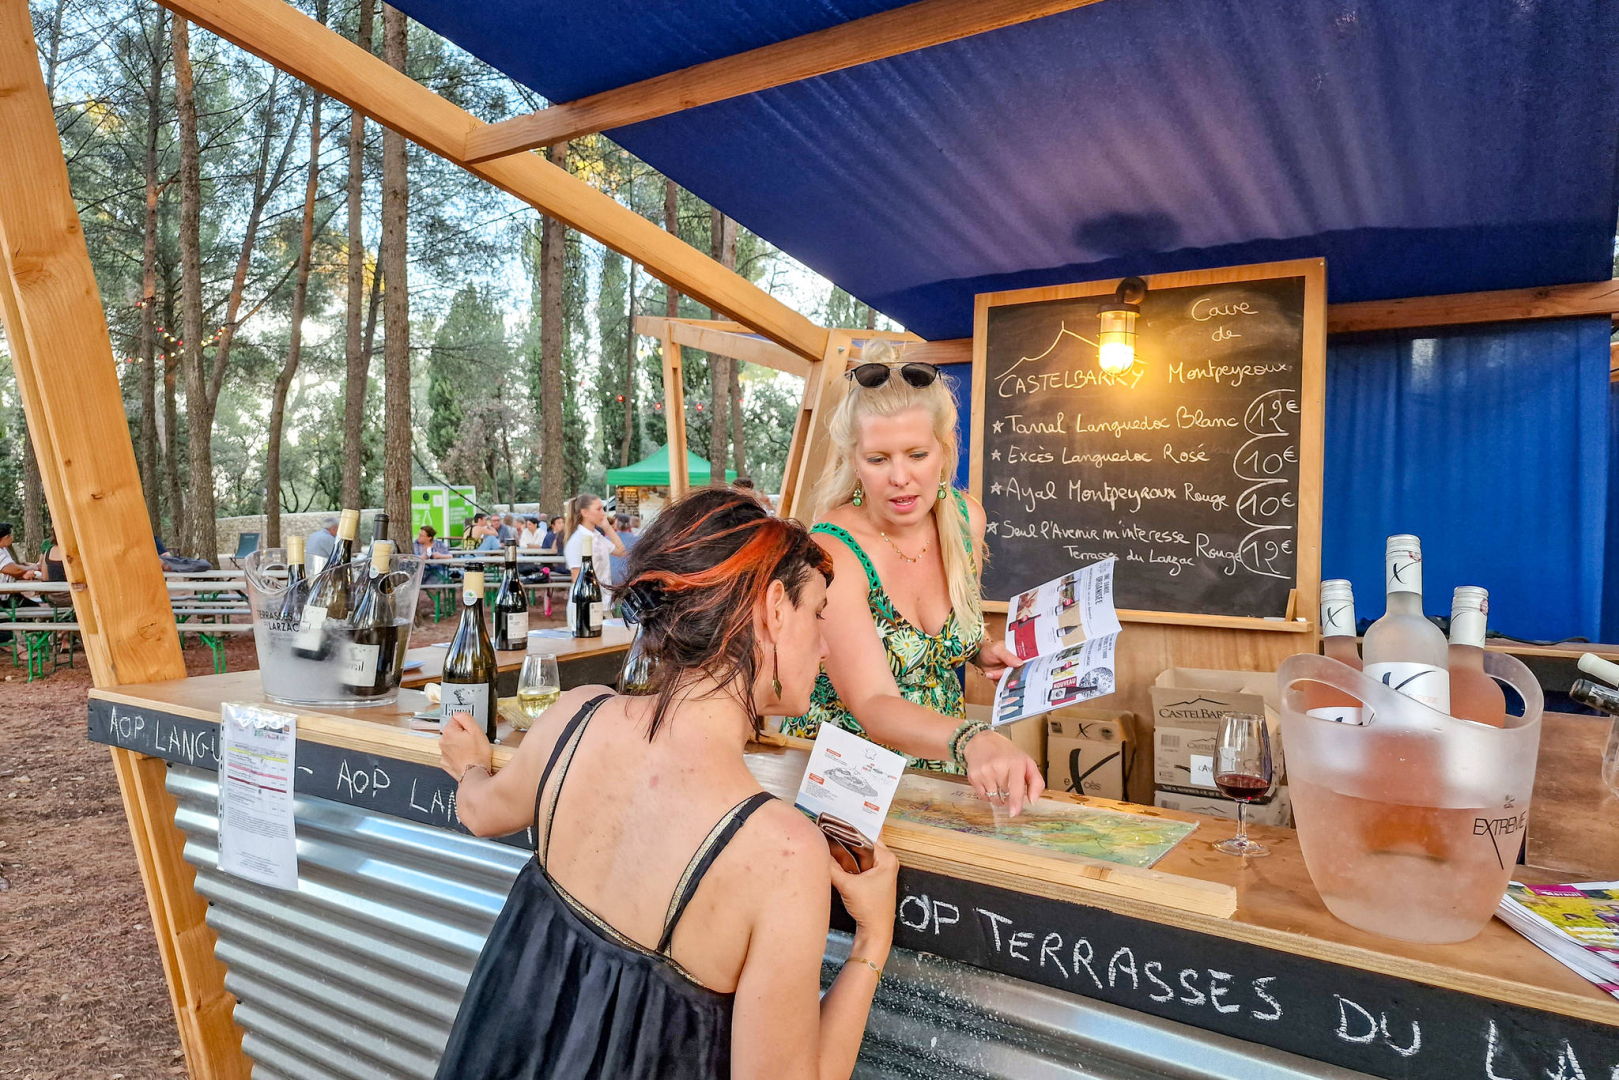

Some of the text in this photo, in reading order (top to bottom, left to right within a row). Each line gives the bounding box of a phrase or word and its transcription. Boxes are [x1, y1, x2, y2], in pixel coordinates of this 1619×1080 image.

[1191, 298, 1259, 321] Cave
[1211, 326, 1242, 342] de
[1168, 359, 1288, 387] Montpeyroux
[1076, 413, 1170, 438] Languedoc
[1176, 405, 1240, 429] Blanc
[1062, 446, 1152, 469] Languedoc
[1163, 443, 1211, 464] Rosé
[1243, 445, 1298, 474] 10€
[1184, 482, 1229, 512] Rouge
[1239, 491, 1296, 516] 10€
[1001, 519, 1039, 539] Seul
[1196, 532, 1242, 576] Rouge
[1126, 549, 1145, 563] du
[1149, 549, 1195, 576] Larzac
[268, 622, 299, 633] LARZAC
[110, 705, 145, 744] AOP
[336, 759, 391, 799] AOP
[899, 894, 960, 936] OP
[973, 906, 1284, 1022] TERRASSES
[1333, 993, 1422, 1057] DU
[1485, 1018, 1619, 1080] LA
